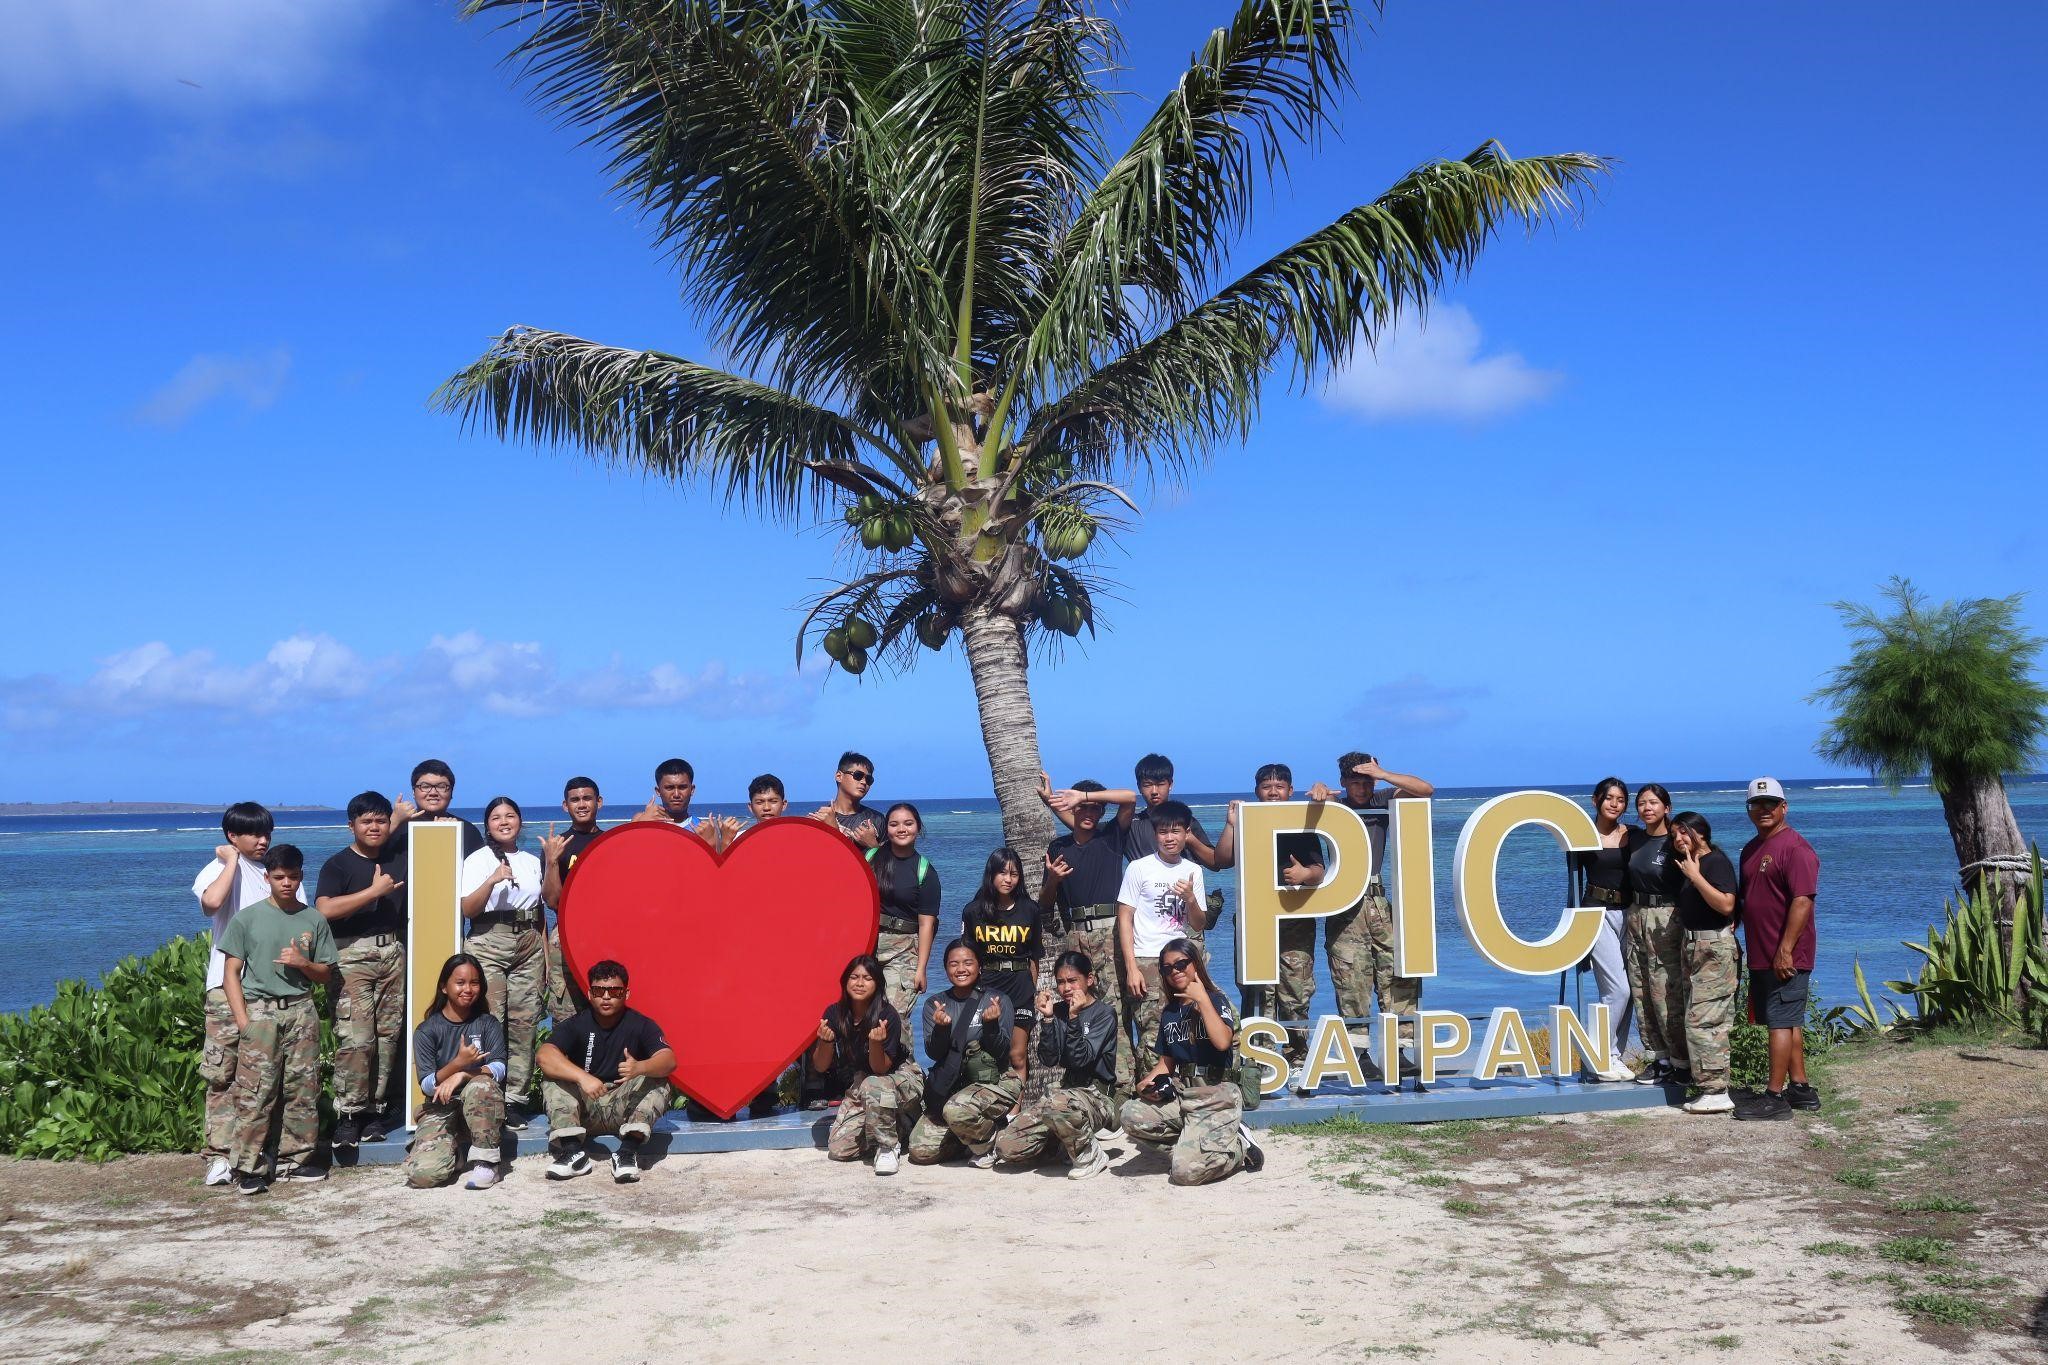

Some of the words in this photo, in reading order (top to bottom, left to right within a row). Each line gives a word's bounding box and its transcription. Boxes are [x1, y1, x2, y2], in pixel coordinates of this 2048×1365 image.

[407, 820, 464, 1131] I
[1236, 790, 1606, 986] PIC
[975, 925, 1031, 943] ARMY
[987, 944, 1016, 954] JROTC
[1238, 1002, 1612, 1095] SAIPAN
